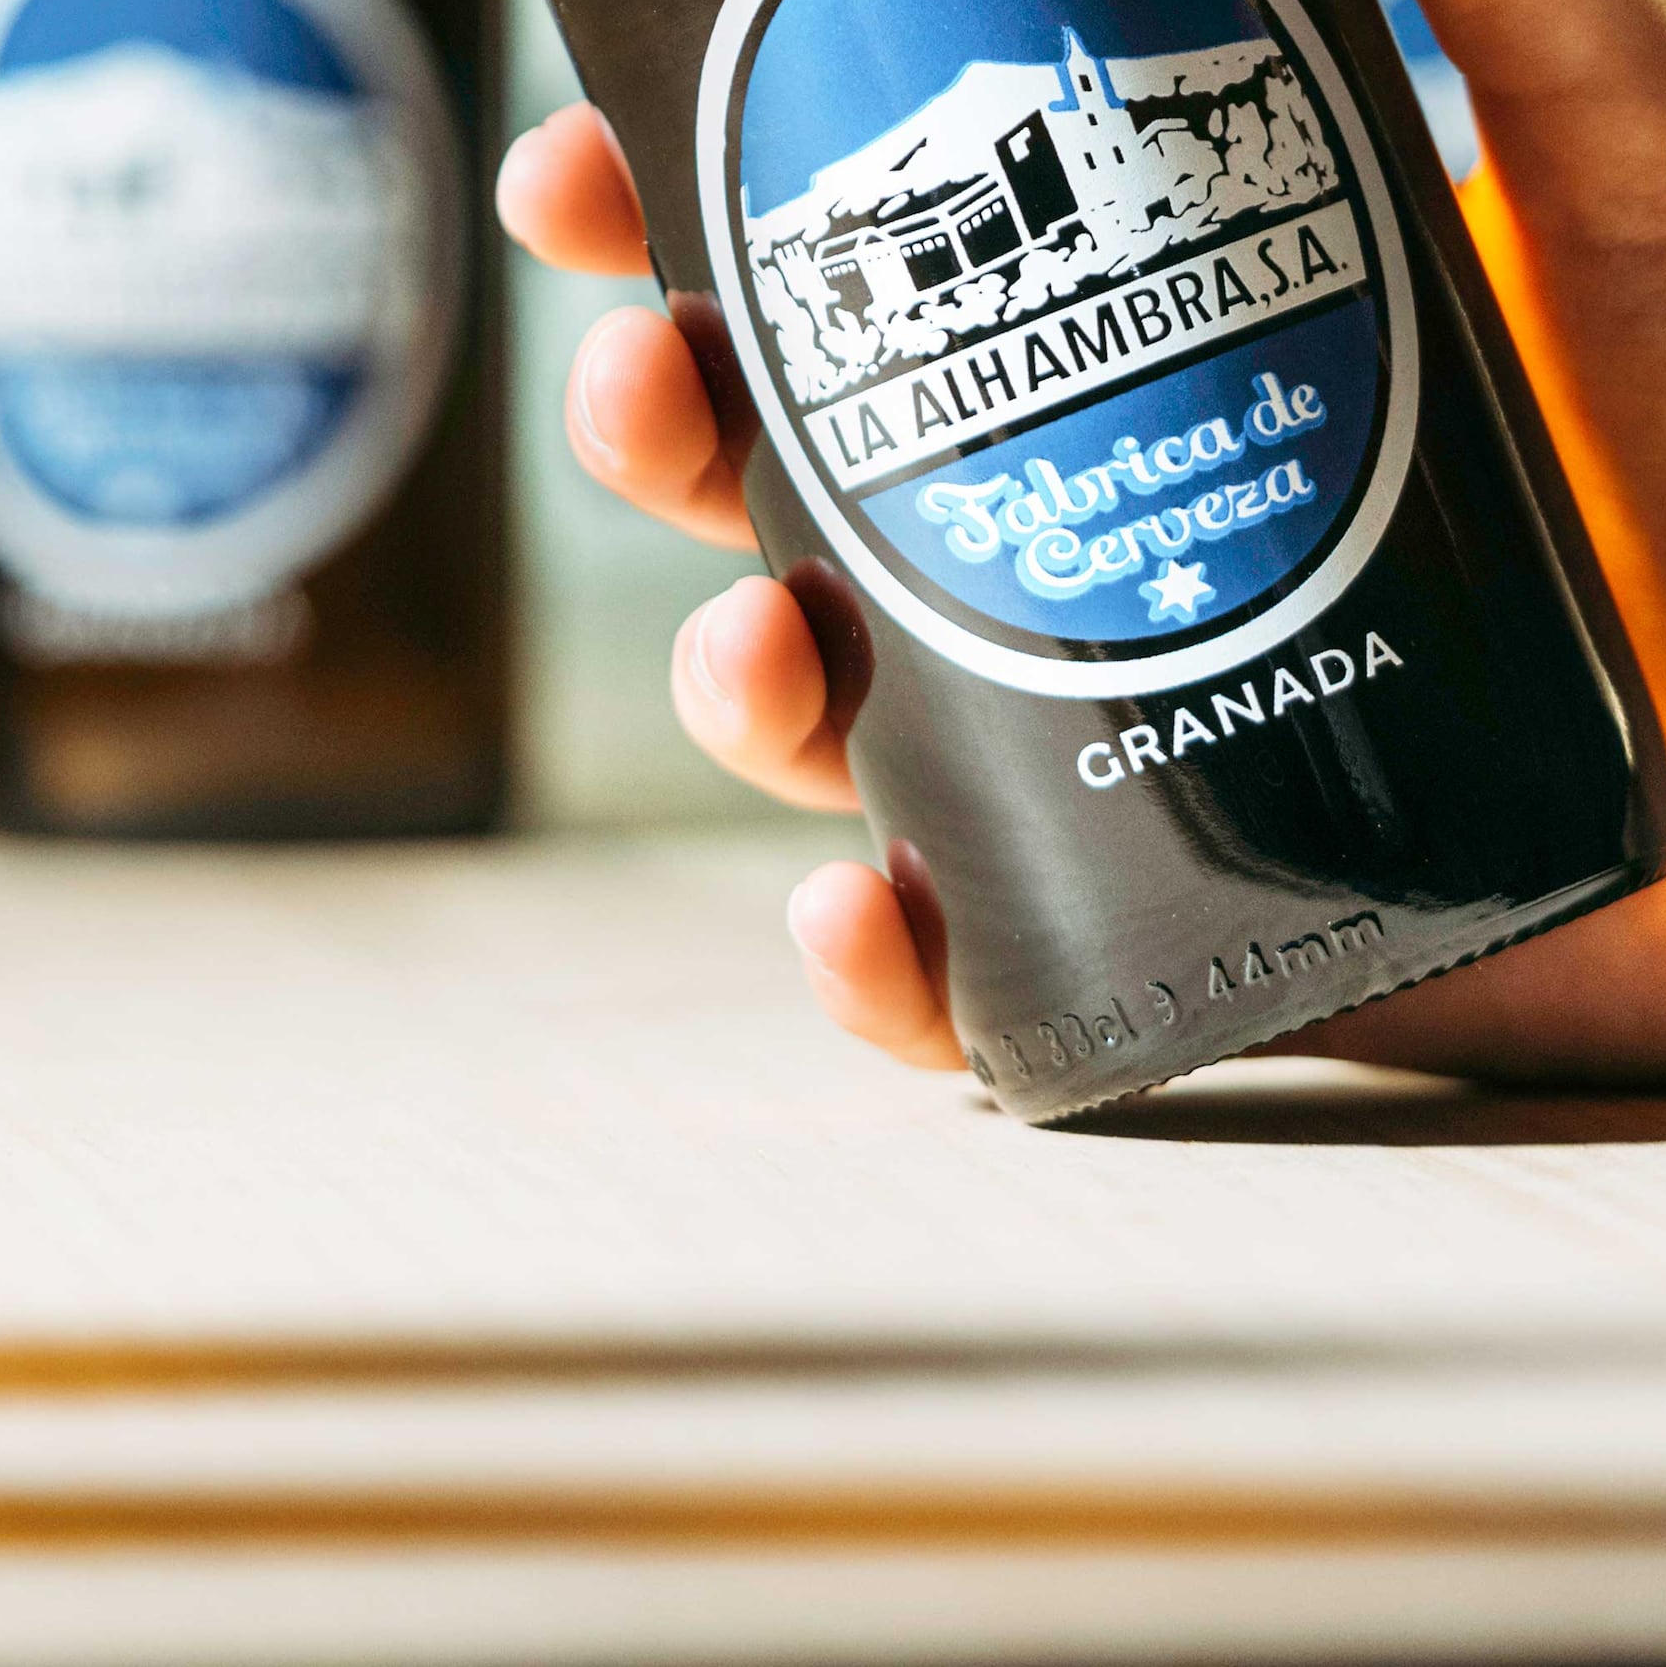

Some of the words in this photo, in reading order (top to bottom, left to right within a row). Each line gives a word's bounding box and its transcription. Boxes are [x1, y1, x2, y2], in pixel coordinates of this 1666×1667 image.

[835, 412, 897, 470] LA
[1252, 371, 1323, 437] de
[1025, 458, 1315, 590] Cerveza
[1075, 629, 1405, 789] GRANADA
[1037, 997, 1139, 1067] 33cl
[1208, 910, 1385, 1002] 44mm
